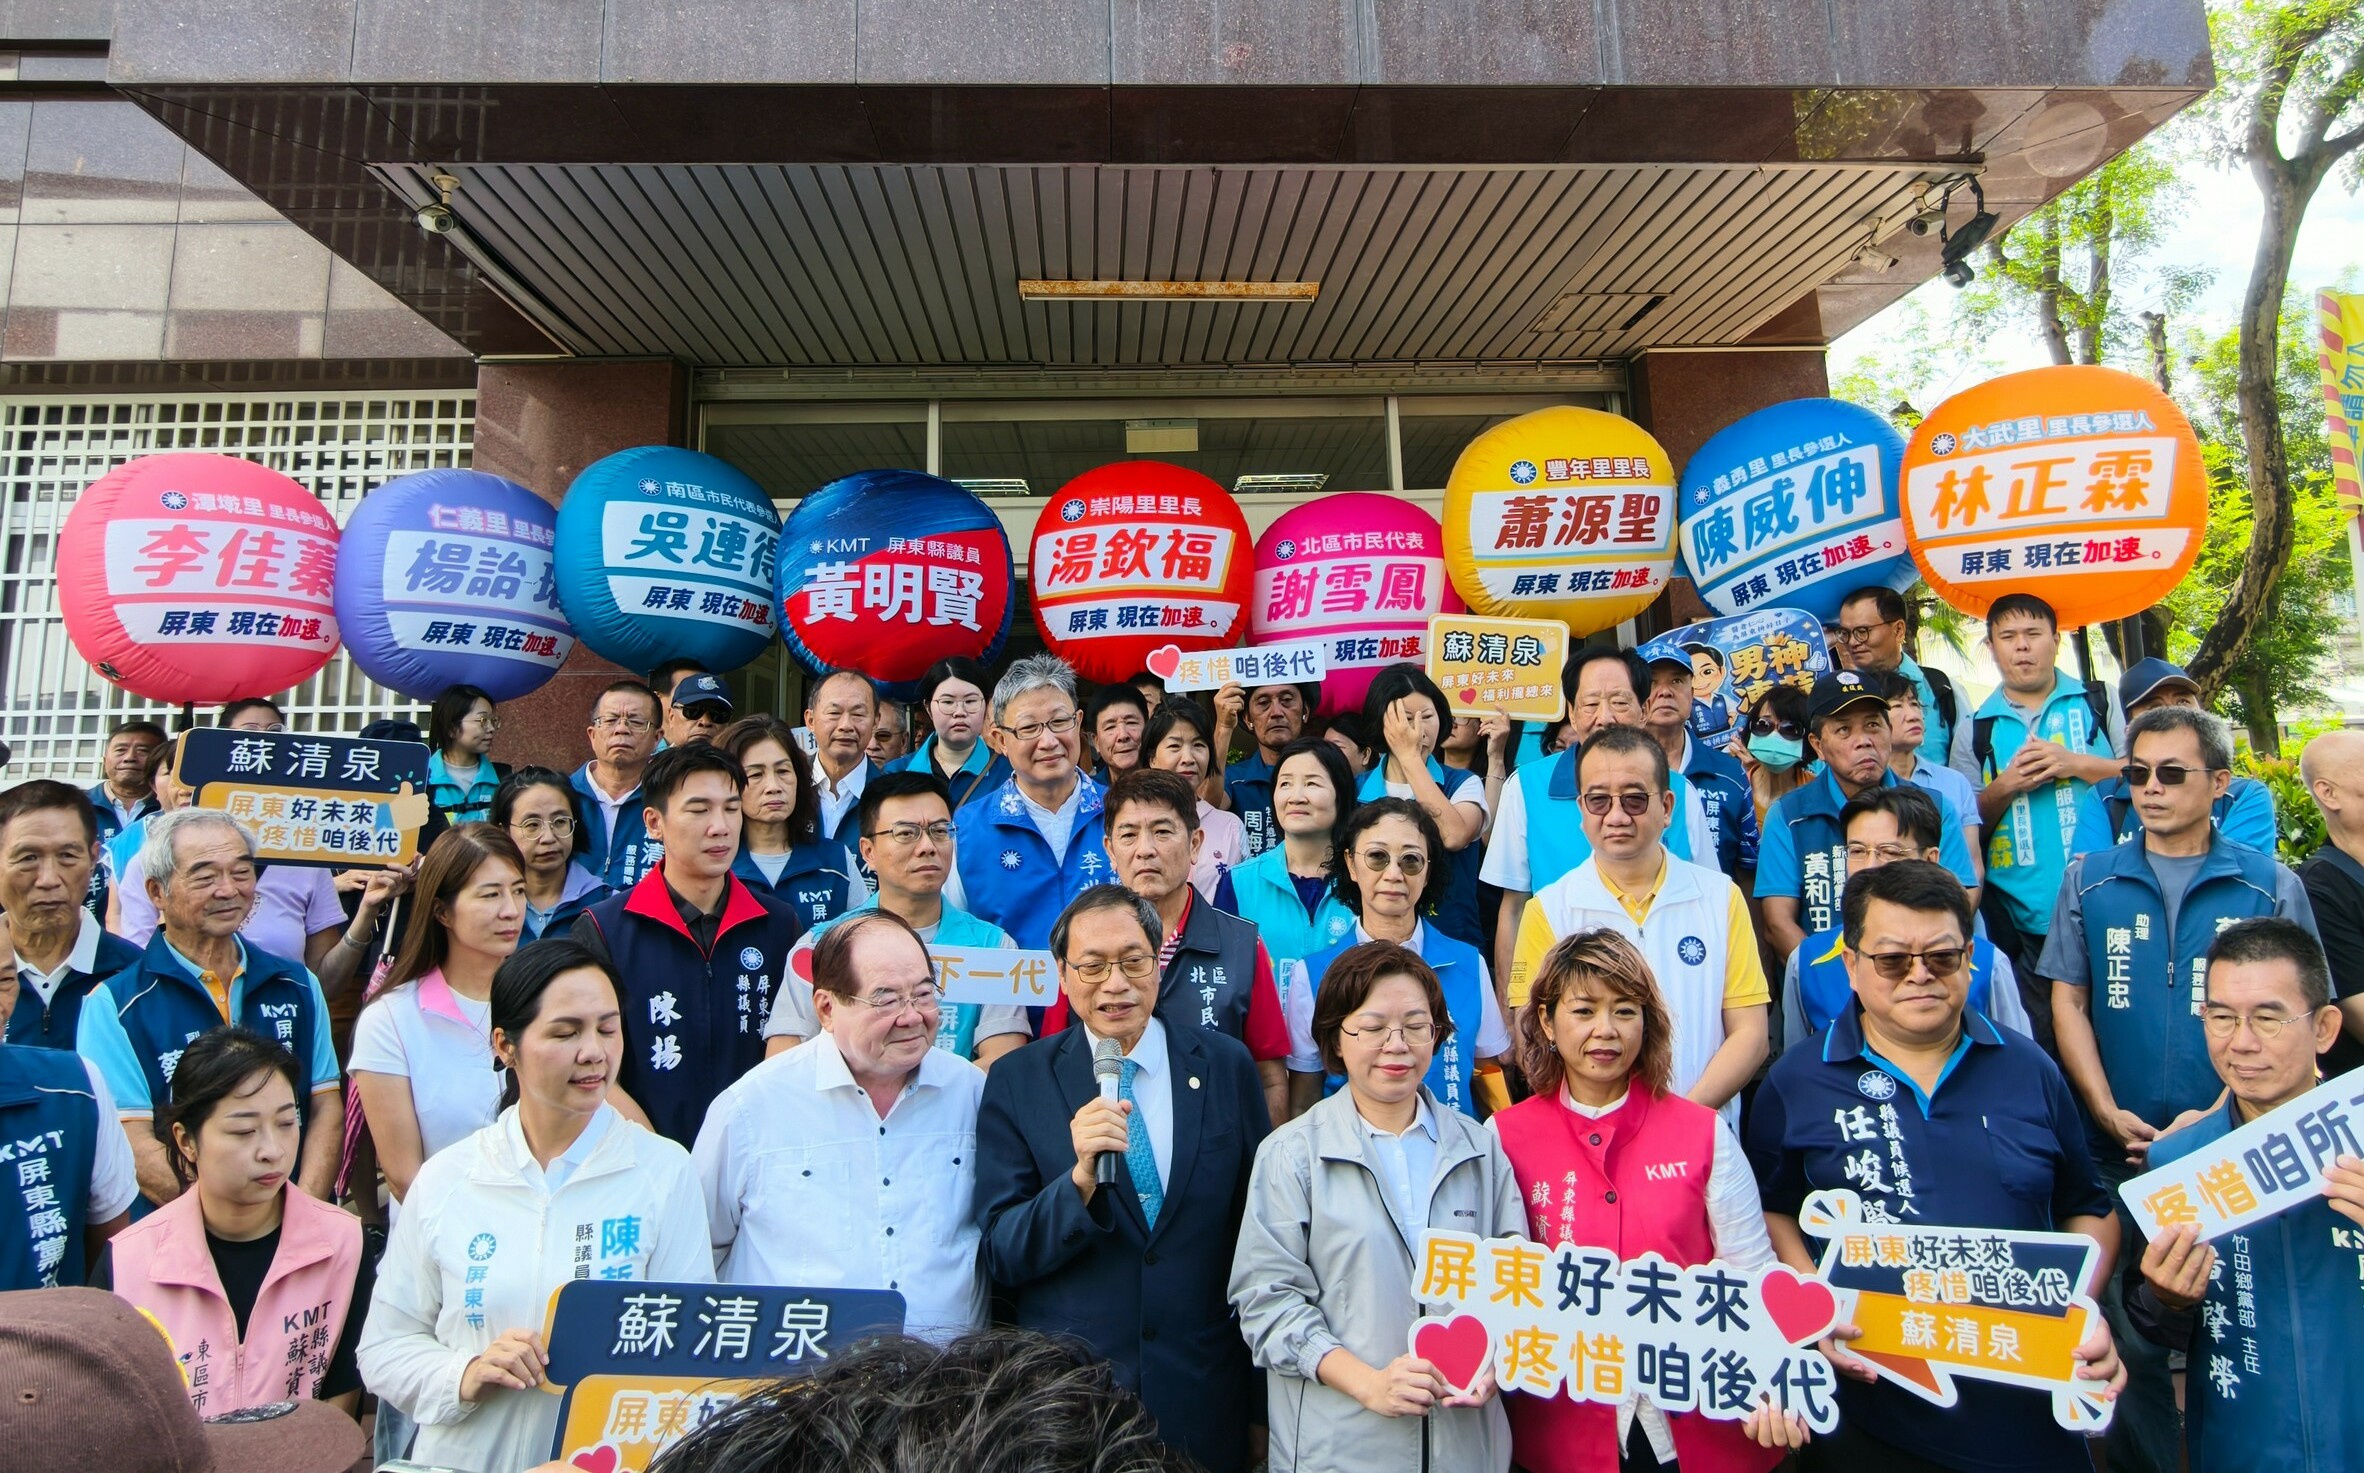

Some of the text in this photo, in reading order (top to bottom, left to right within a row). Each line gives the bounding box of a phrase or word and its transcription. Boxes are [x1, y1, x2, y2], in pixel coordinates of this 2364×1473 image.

[1961, 411, 2155, 450] 大武里 里長參選人
[1546, 458, 1651, 481] 豐年里里長
[1713, 433, 1852, 495] 義勇里 里長參選人
[1090, 495, 1202, 517] 崇陽里里長
[1930, 450, 2153, 530] 林正霖
[192, 493, 335, 534] 潭墩里 里長參選人
[429, 504, 510, 536] 仁義里
[1494, 494, 1661, 549] 蕭源聖
[1692, 457, 1867, 577] 陳威伸
[133, 524, 339, 598] 李佳蓁
[827, 537, 981, 565] KMT 屏東縣議員
[1047, 528, 1217, 586] 湯欽福
[1301, 532, 1424, 556] 北區市民代表
[1961, 536, 2161, 575] 屏東 現在加速。
[1511, 567, 1659, 595] 屏東 現在加速。
[1731, 535, 1892, 607] 屏東 現在加速。
[642, 586, 774, 628] 屏東 現在加速。
[802, 561, 985, 632] 黃明賢
[1267, 564, 1427, 622] 謝雪鳳
[157, 610, 330, 643] 屏東 現在加速。
[1069, 605, 1217, 632] 屏東 現在加速。
[422, 621, 562, 659] 屏東 現在加速。
[1334, 637, 1425, 662] 現在加速
[1443, 631, 1541, 665] 蘇清泉
[1179, 650, 1316, 684] 疼惜咱後代
[1441, 668, 1516, 689] 屏東好未來
[1730, 641, 1809, 685] 男神
[1482, 684, 1553, 703] 福利攏總來
[227, 738, 381, 781] 蘇清泉
[229, 795, 375, 824] 屏東好未來
[262, 825, 399, 853] 疼惜咱後代
[799, 889, 833, 904] KMT
[1804, 852, 1831, 932] 黃和田
[812, 905, 828, 926] 屏
[2134, 913, 2150, 940] 助理
[1190, 966, 1228, 985] 北區
[2106, 927, 2132, 1009] 陳正忠
[260, 1003, 298, 1018] KMT
[736, 975, 752, 1034] 縣議員
[649, 991, 683, 1071] 陳揚
[1645, 1161, 1688, 1181] KMT
[1878, 1103, 1920, 1215] 縣議員候選人
[2141, 1087, 2364, 1230] 疼惜咱所
[1560, 1170, 1578, 1243] 屏東縣議
[1844, 1234, 2011, 1265] 屏東好未來
[465, 1265, 489, 1332] 屏東市
[1420, 1237, 1750, 1333] 屏東好未來
[1908, 1271, 2069, 1302] 疼惜咱後代
[2232, 1233, 2262, 1375] 竹田鄉黨部 主任
[284, 1301, 332, 1334] KMT
[612, 1292, 829, 1361] 蘇清泉
[1900, 1309, 2023, 1362] 蘇清泉
[285, 1333, 309, 1399] 蘇資
[1503, 1325, 1829, 1424] 疼惜咱後代
